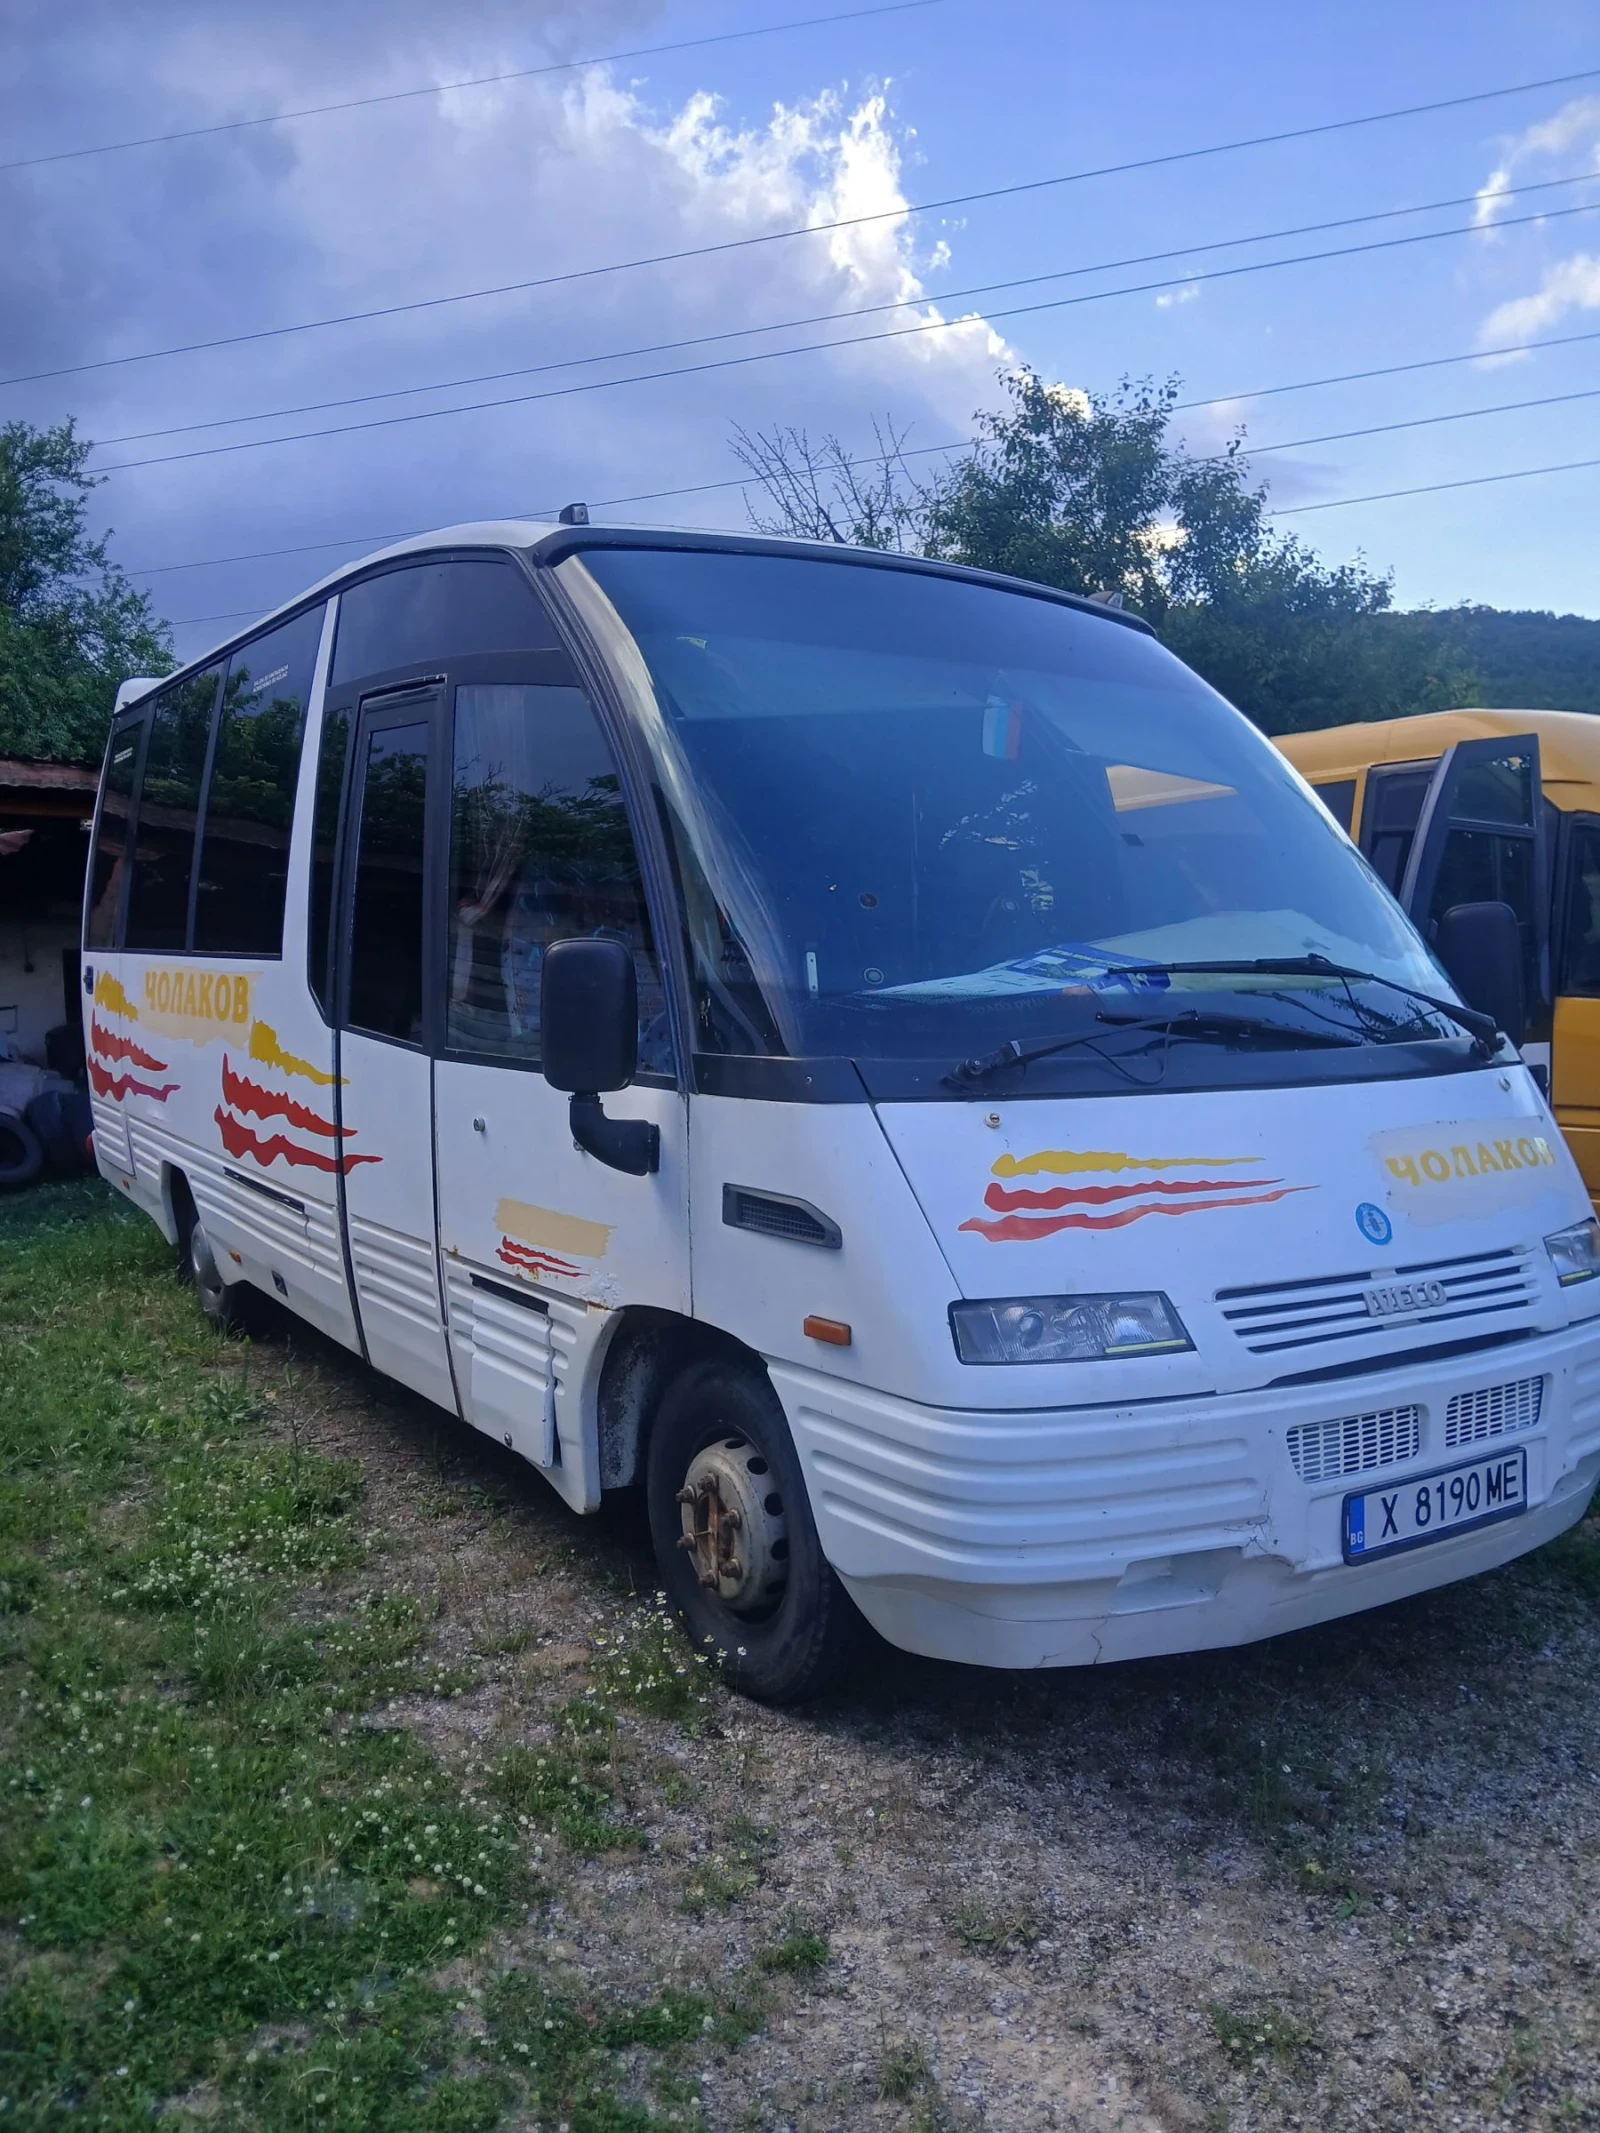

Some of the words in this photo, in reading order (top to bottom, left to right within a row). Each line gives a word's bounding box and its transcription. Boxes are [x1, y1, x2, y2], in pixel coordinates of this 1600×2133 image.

[145, 971, 249, 1024] ЧОЛАКОВ
[1362, 1280, 1448, 1318] IVECO
[1381, 1493, 1399, 1538] X
[1415, 1472, 1480, 1527] 8190
[1486, 1459, 1519, 1506] ME
[1350, 1530, 1364, 1546] BG
